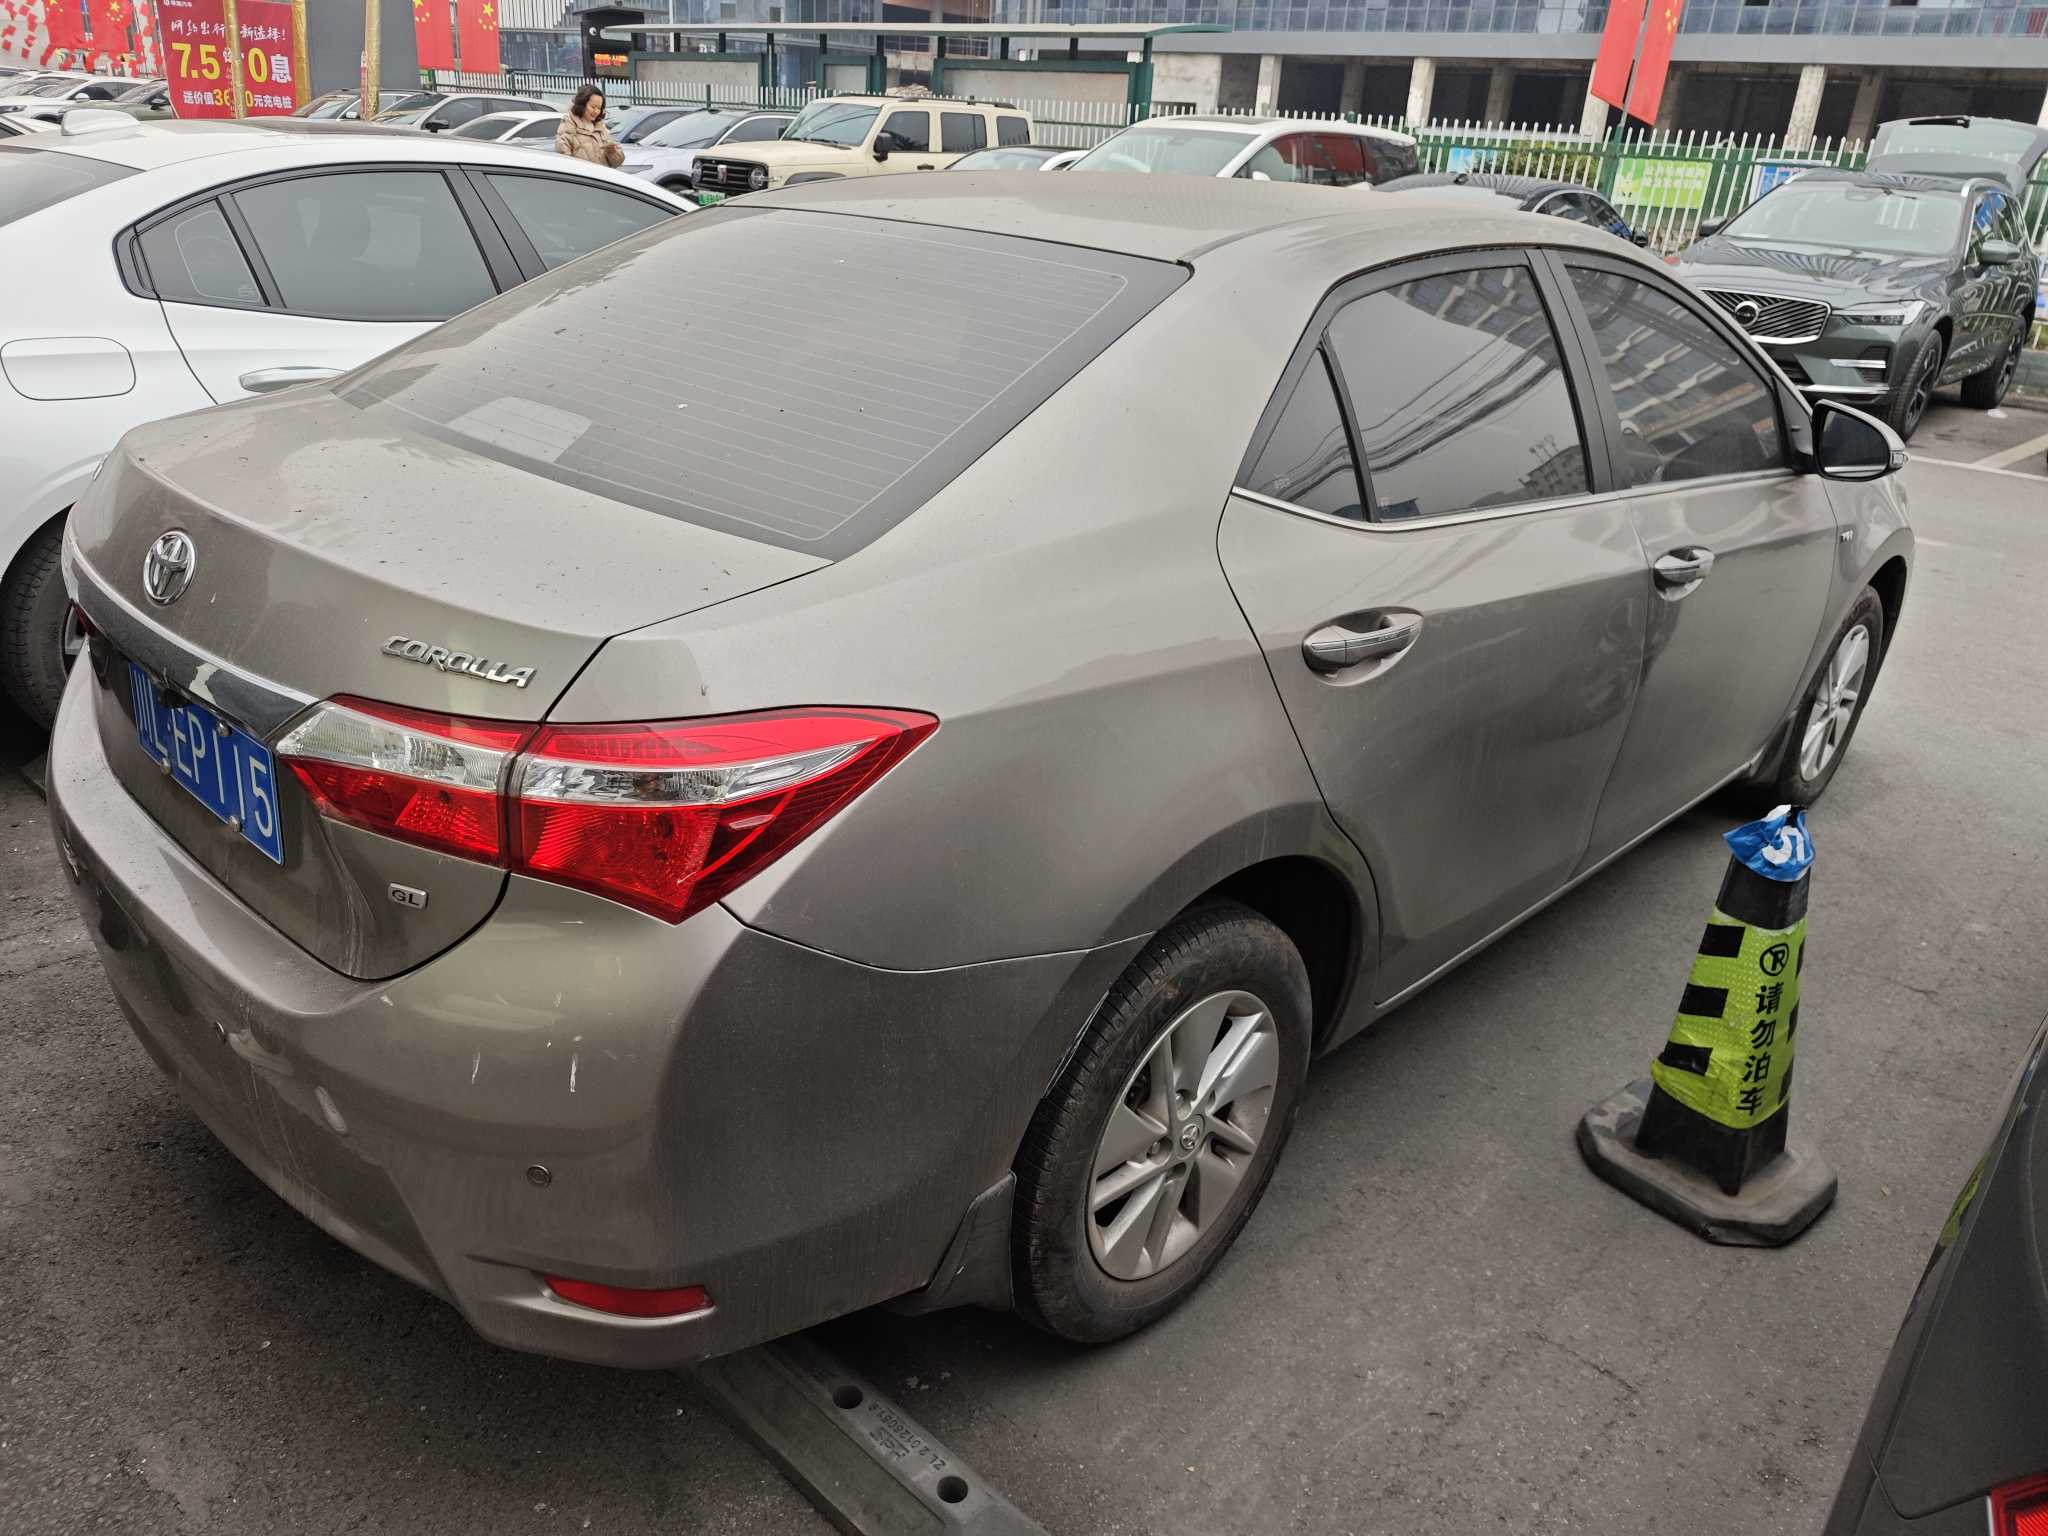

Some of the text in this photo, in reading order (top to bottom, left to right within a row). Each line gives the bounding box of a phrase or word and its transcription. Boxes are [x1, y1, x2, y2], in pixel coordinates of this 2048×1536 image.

[382, 635, 536, 689] COROLLA
[391, 889, 420, 906] GL
[1735, 981, 1785, 1116] 请勿泊车
